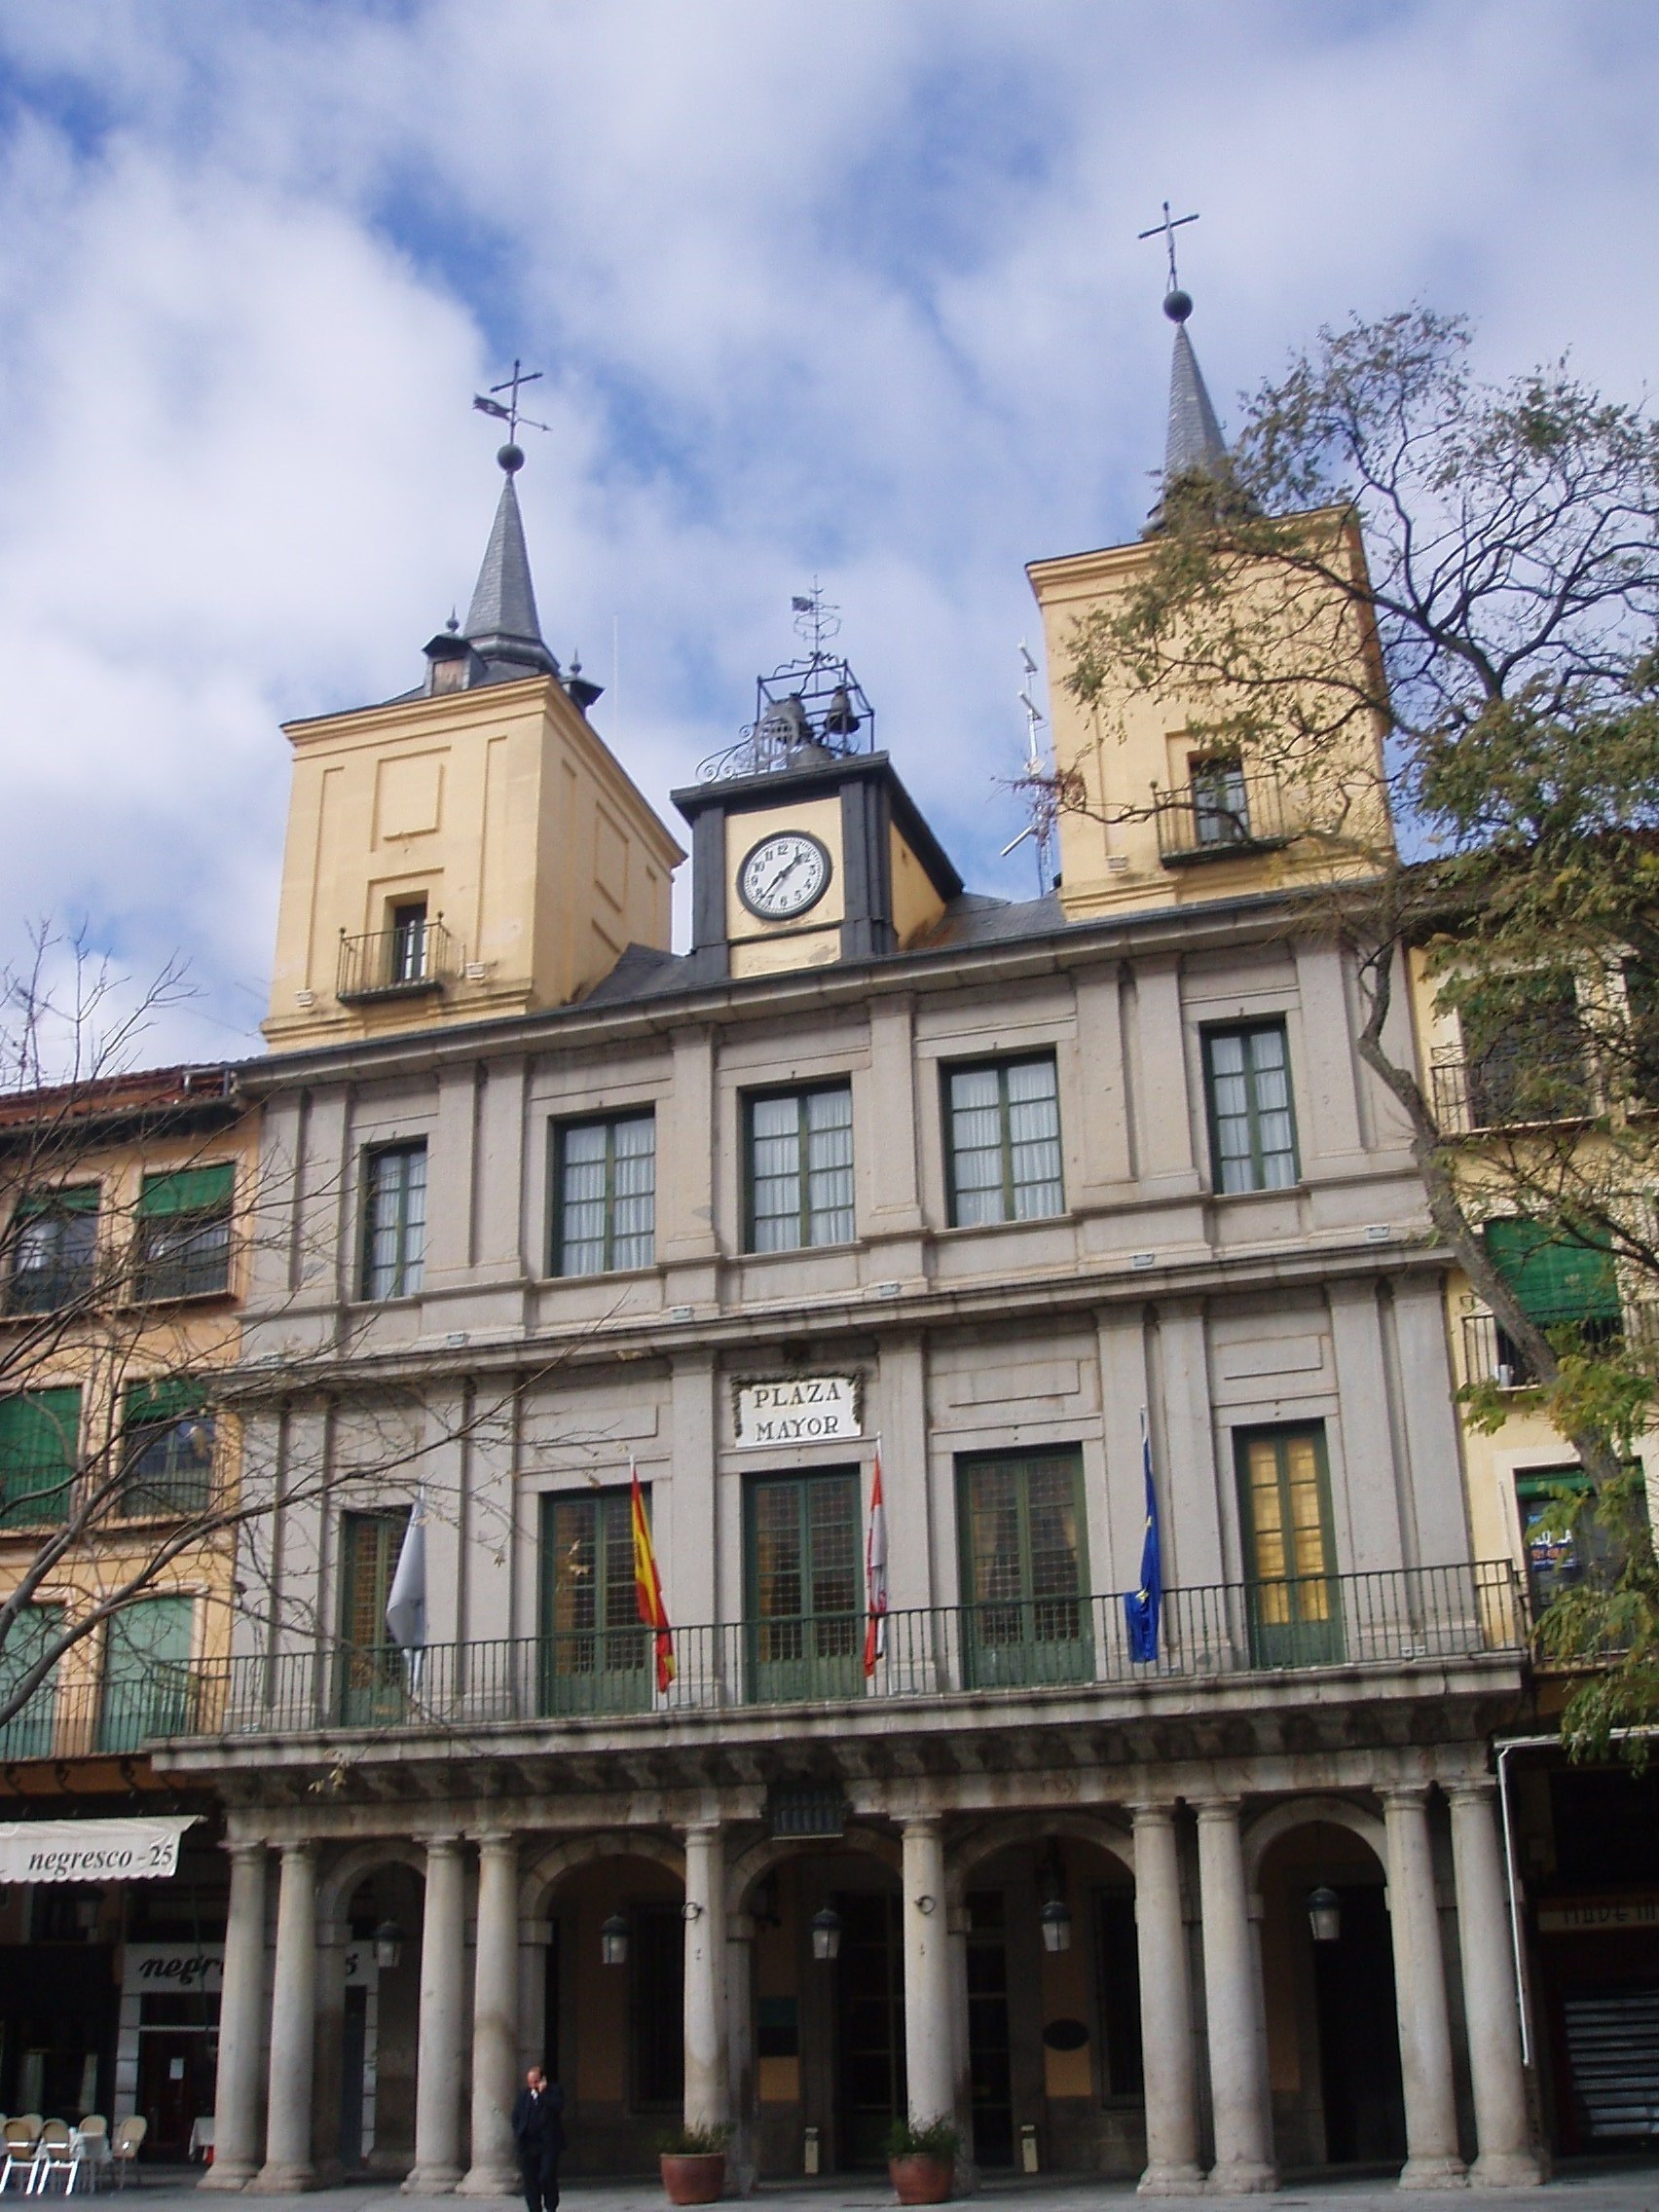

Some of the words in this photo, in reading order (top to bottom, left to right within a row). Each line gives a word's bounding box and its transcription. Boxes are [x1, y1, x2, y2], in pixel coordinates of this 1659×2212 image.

[755, 1382, 841, 1408] PLAZA
[756, 1416, 838, 1441] MAYOR
[28, 1848, 132, 1877] negresco
